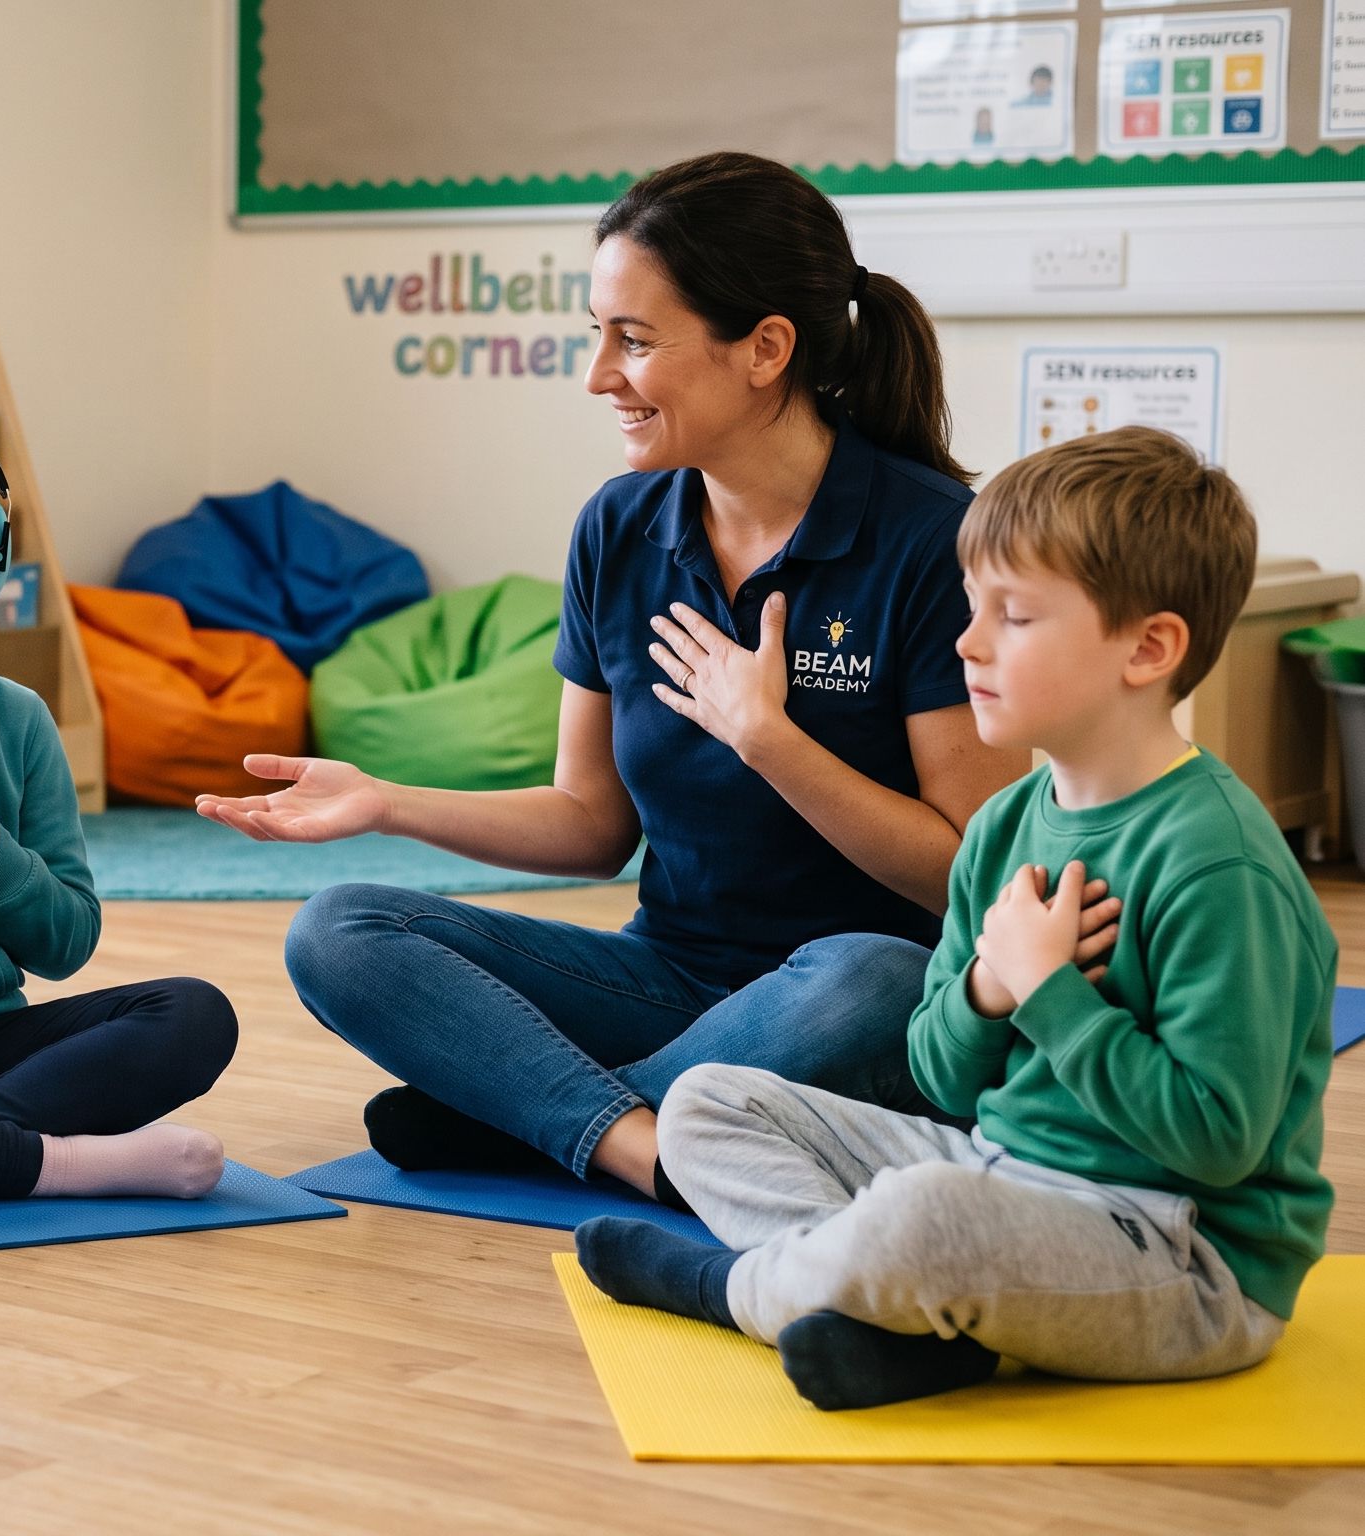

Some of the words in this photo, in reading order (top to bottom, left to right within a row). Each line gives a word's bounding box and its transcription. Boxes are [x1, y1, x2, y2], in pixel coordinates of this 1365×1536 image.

[1168, 29, 1265, 49] resources
[344, 253, 592, 314] wellbein
[394, 335, 589, 377] corner
[1043, 361, 1086, 381] SEN
[1090, 363, 1198, 382] resources
[794, 650, 871, 677] BEAM
[792, 674, 870, 693] ACADEMY
